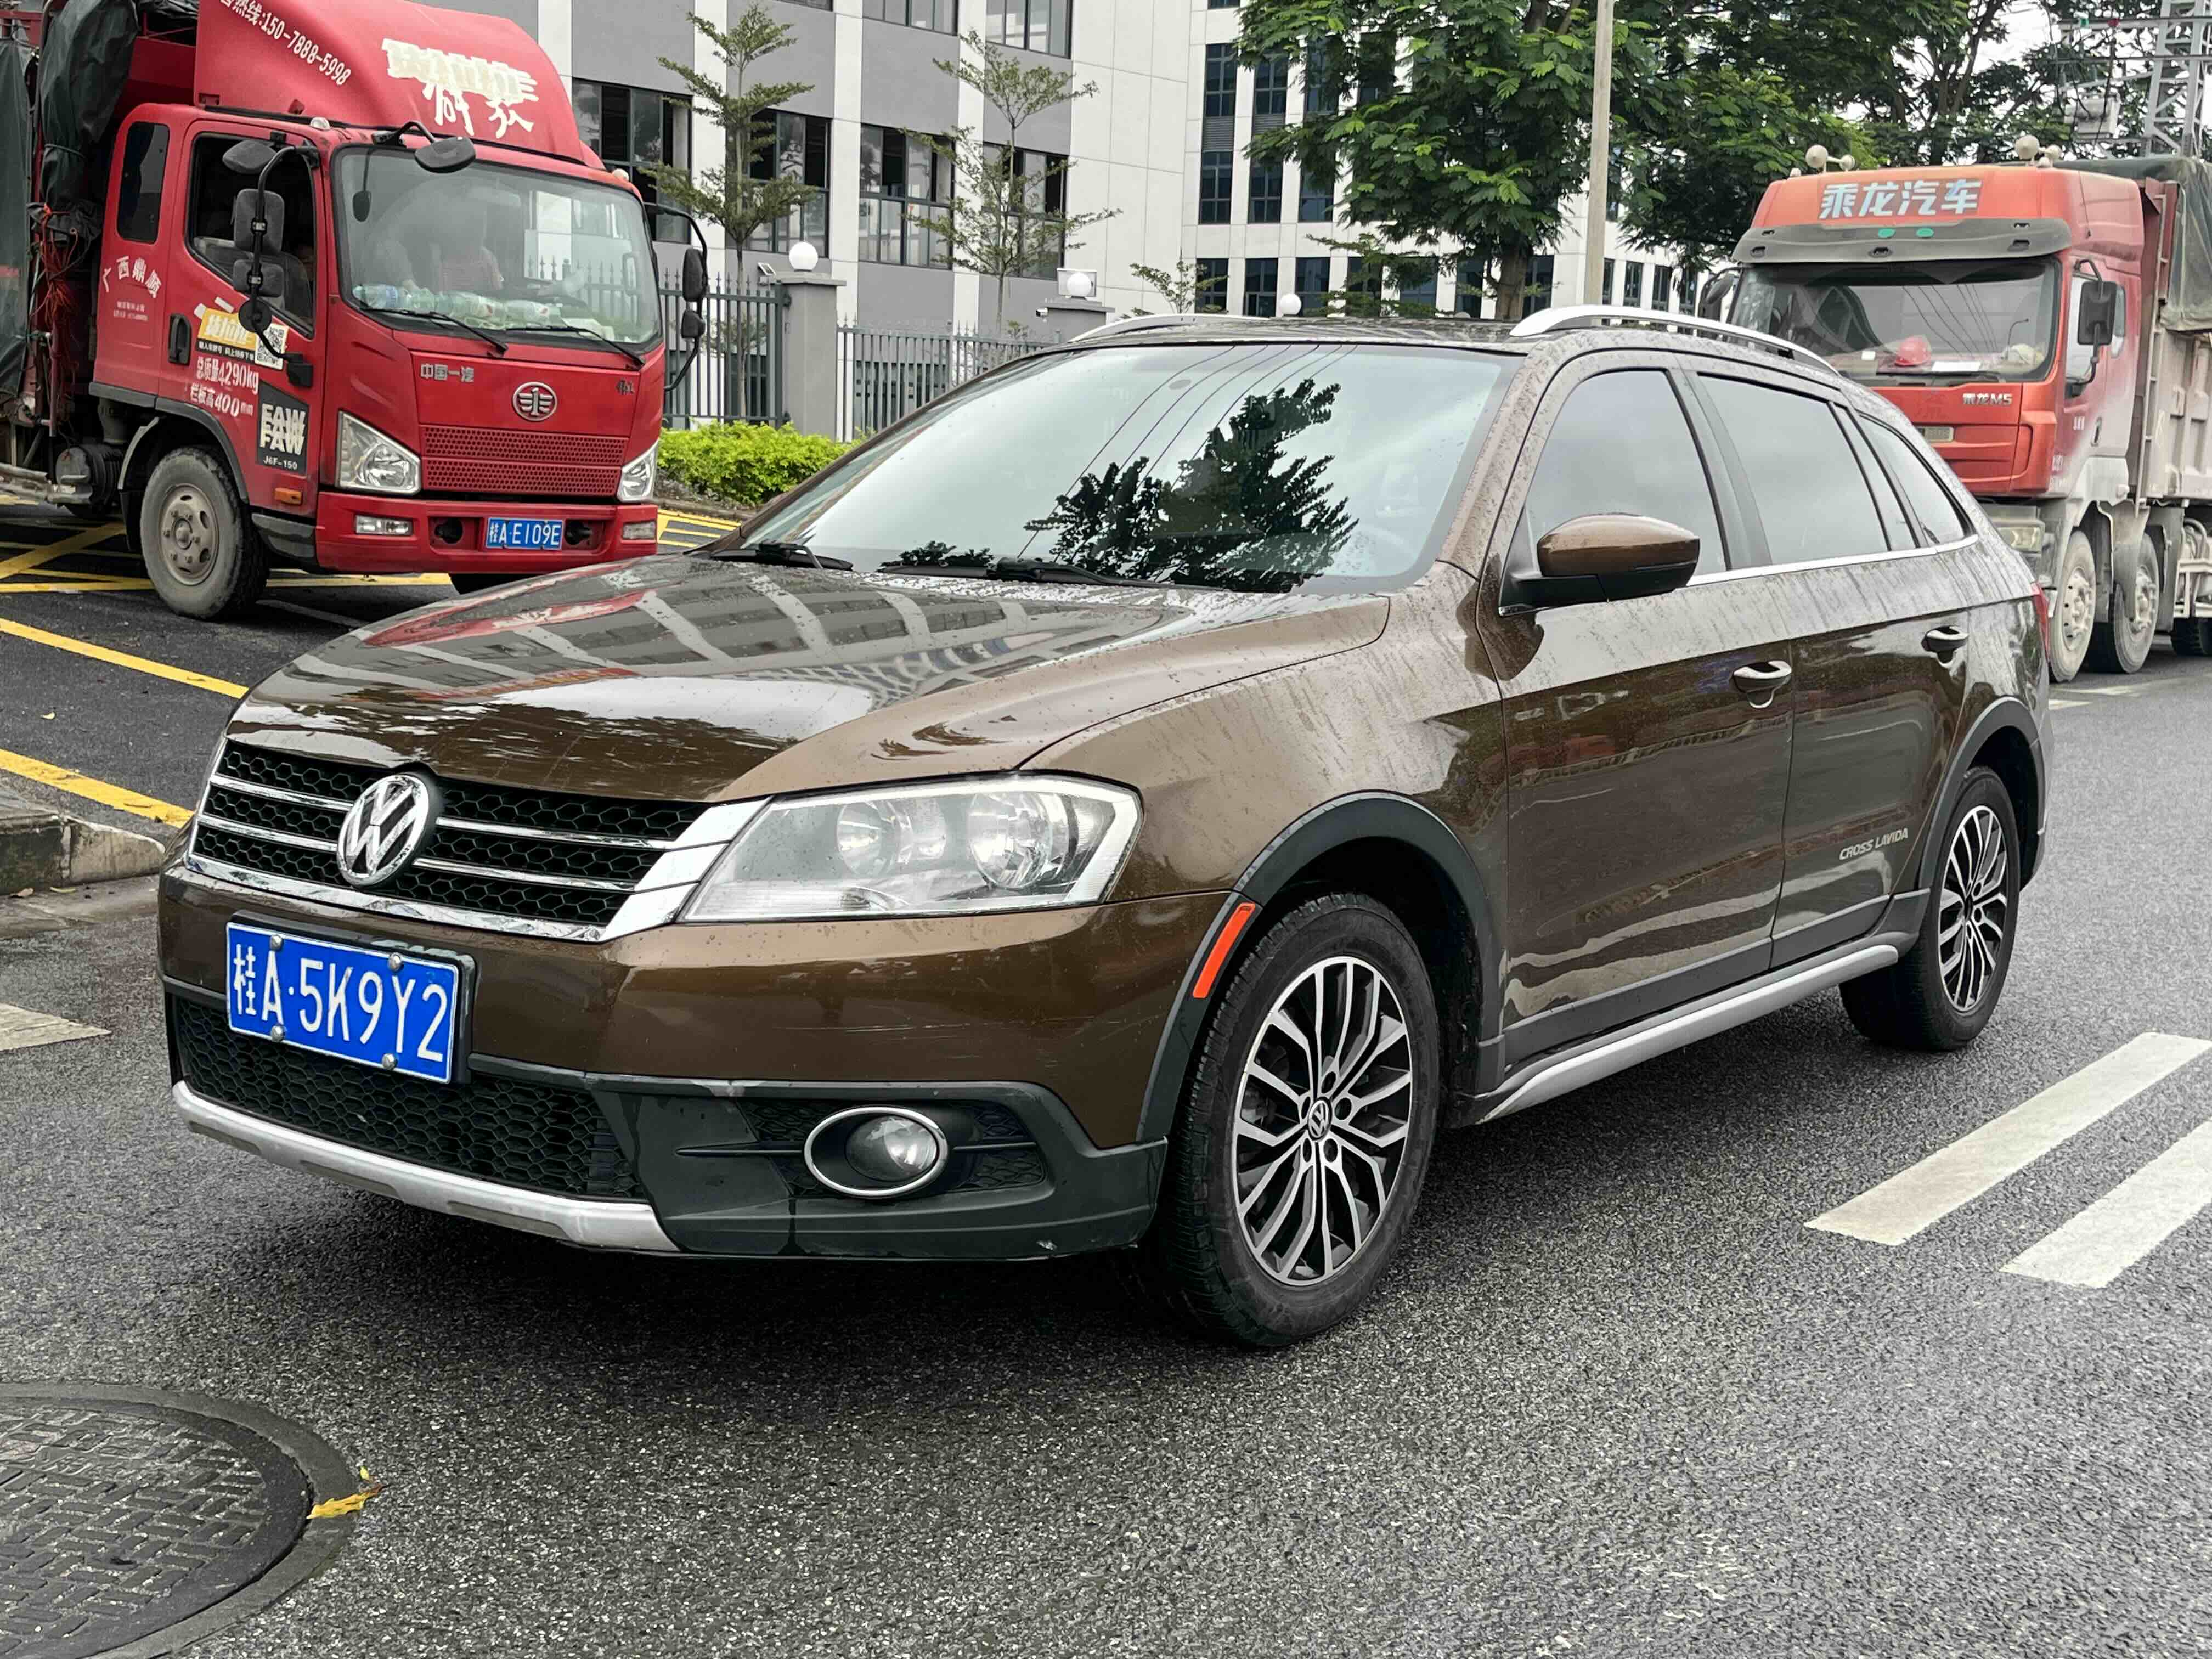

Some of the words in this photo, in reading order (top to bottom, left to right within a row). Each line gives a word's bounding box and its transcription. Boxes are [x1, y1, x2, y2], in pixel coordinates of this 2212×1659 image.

[1819, 179, 1982, 219] 乘龙汽车
[421, 363, 474, 382] 中国一汽
[1962, 393, 2013, 405] 乘龙M5
[1839, 839, 1874, 861] CROSS
[1875, 827, 1909, 849] LAVIDA
